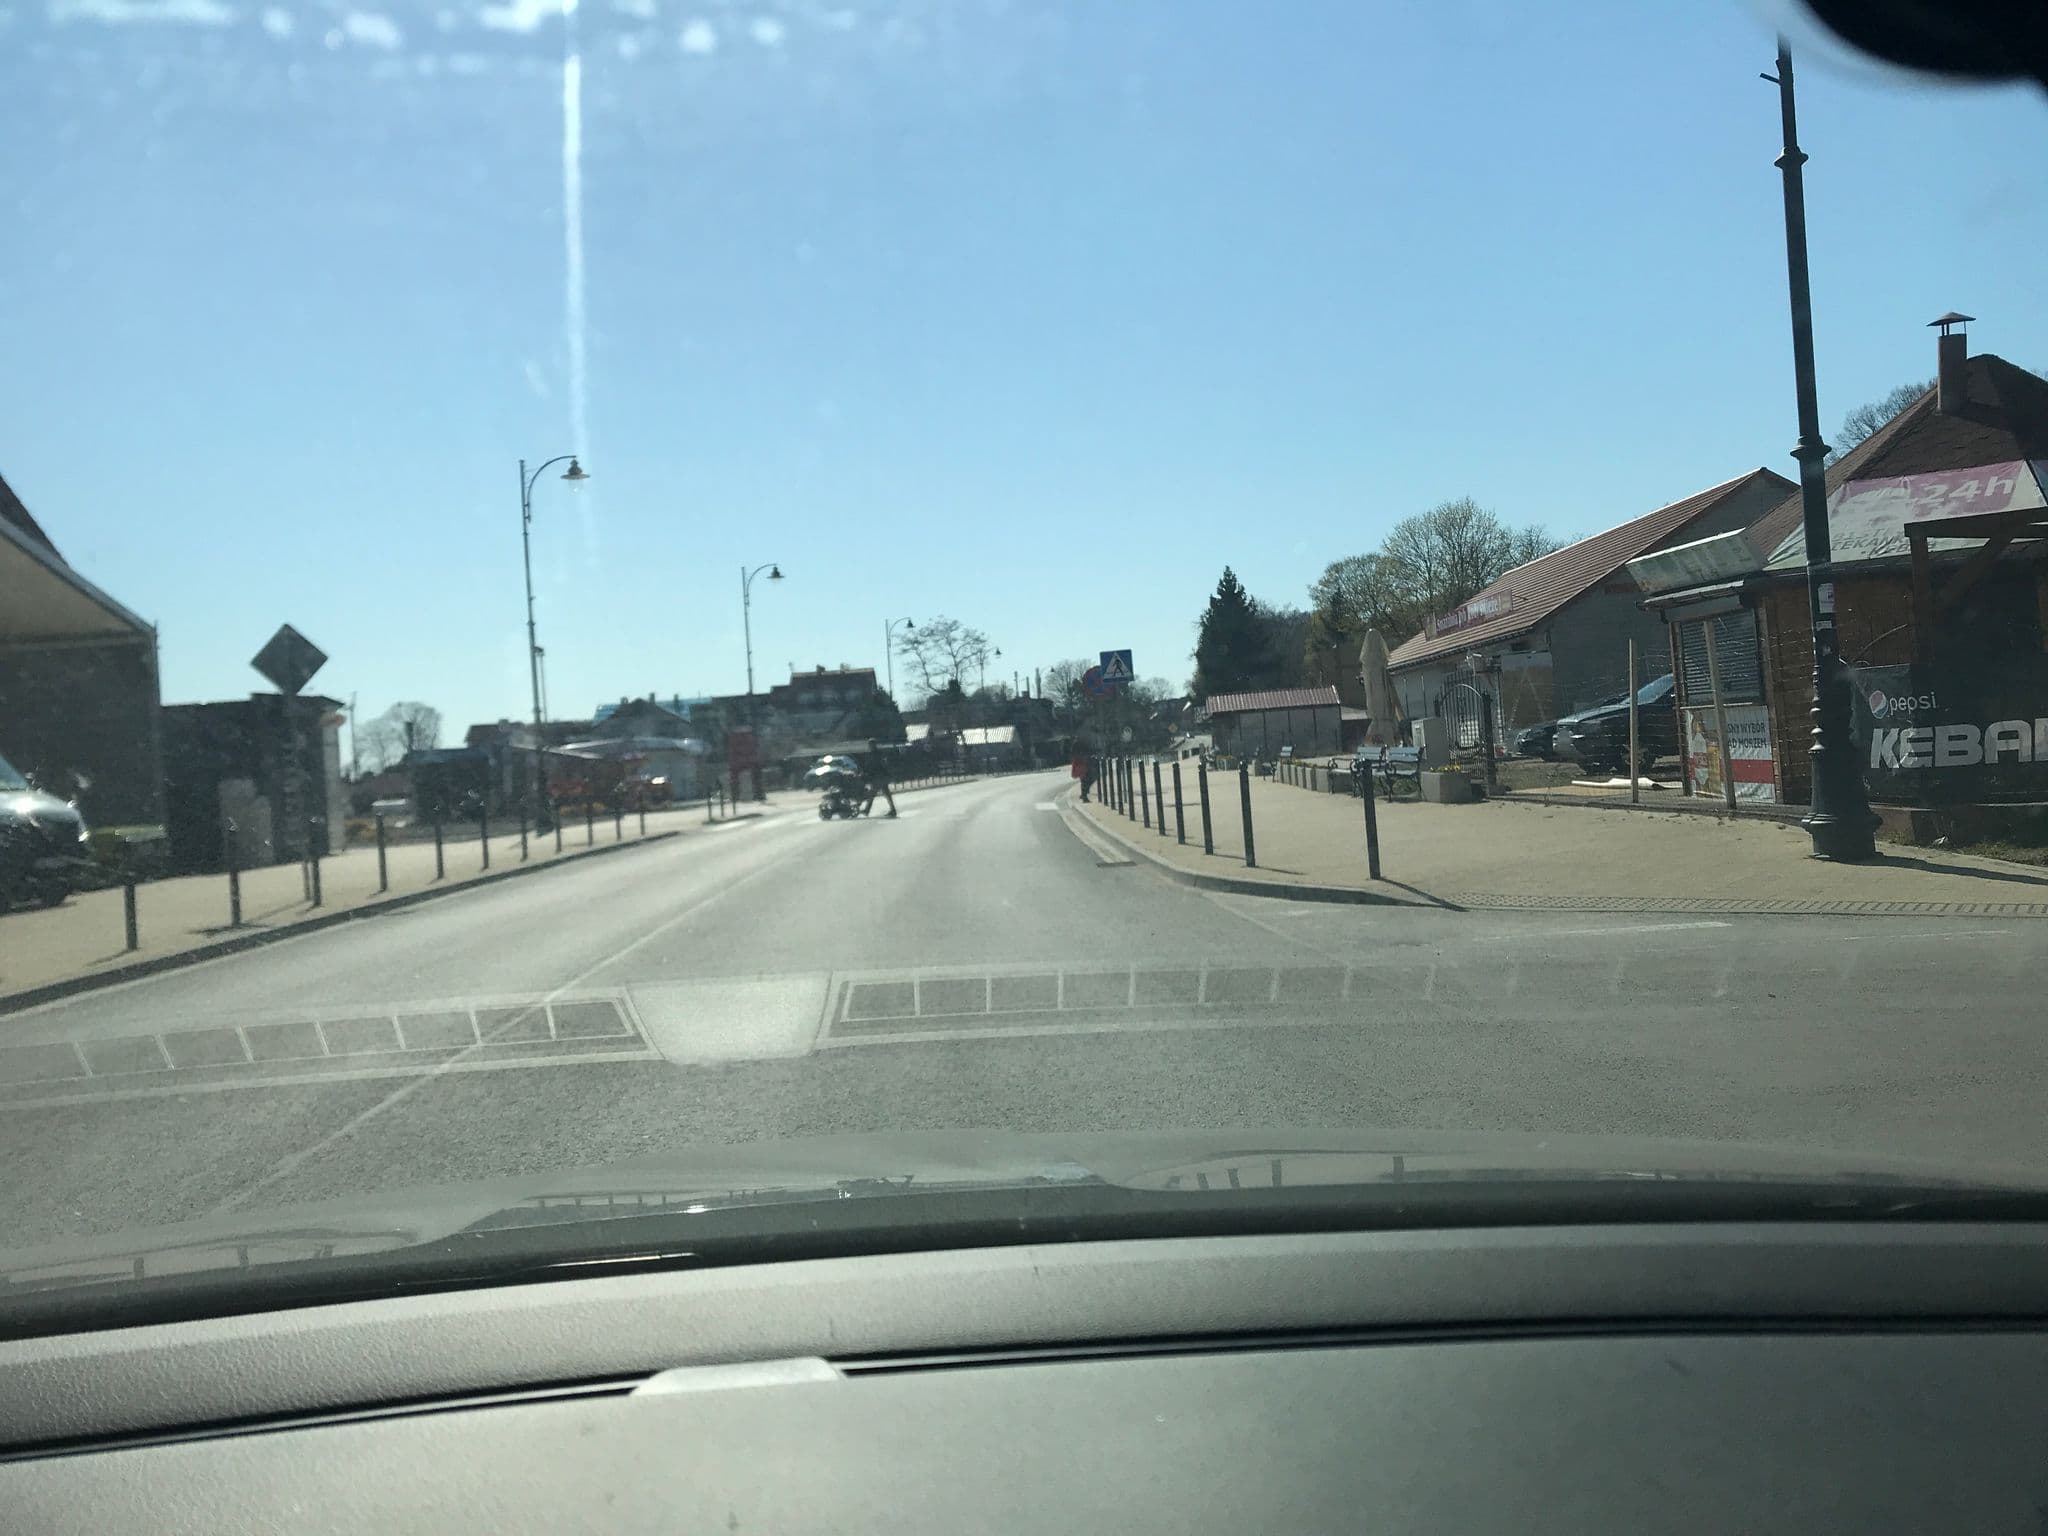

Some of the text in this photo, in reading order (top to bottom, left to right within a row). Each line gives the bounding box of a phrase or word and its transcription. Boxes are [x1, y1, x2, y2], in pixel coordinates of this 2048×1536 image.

[1916, 476, 2014, 504] 24h
[1889, 691, 1937, 716] pepsi
[1728, 723, 1740, 734] SNY
[1728, 737, 1737, 749] AD
[1870, 718, 2048, 769] KEBA
